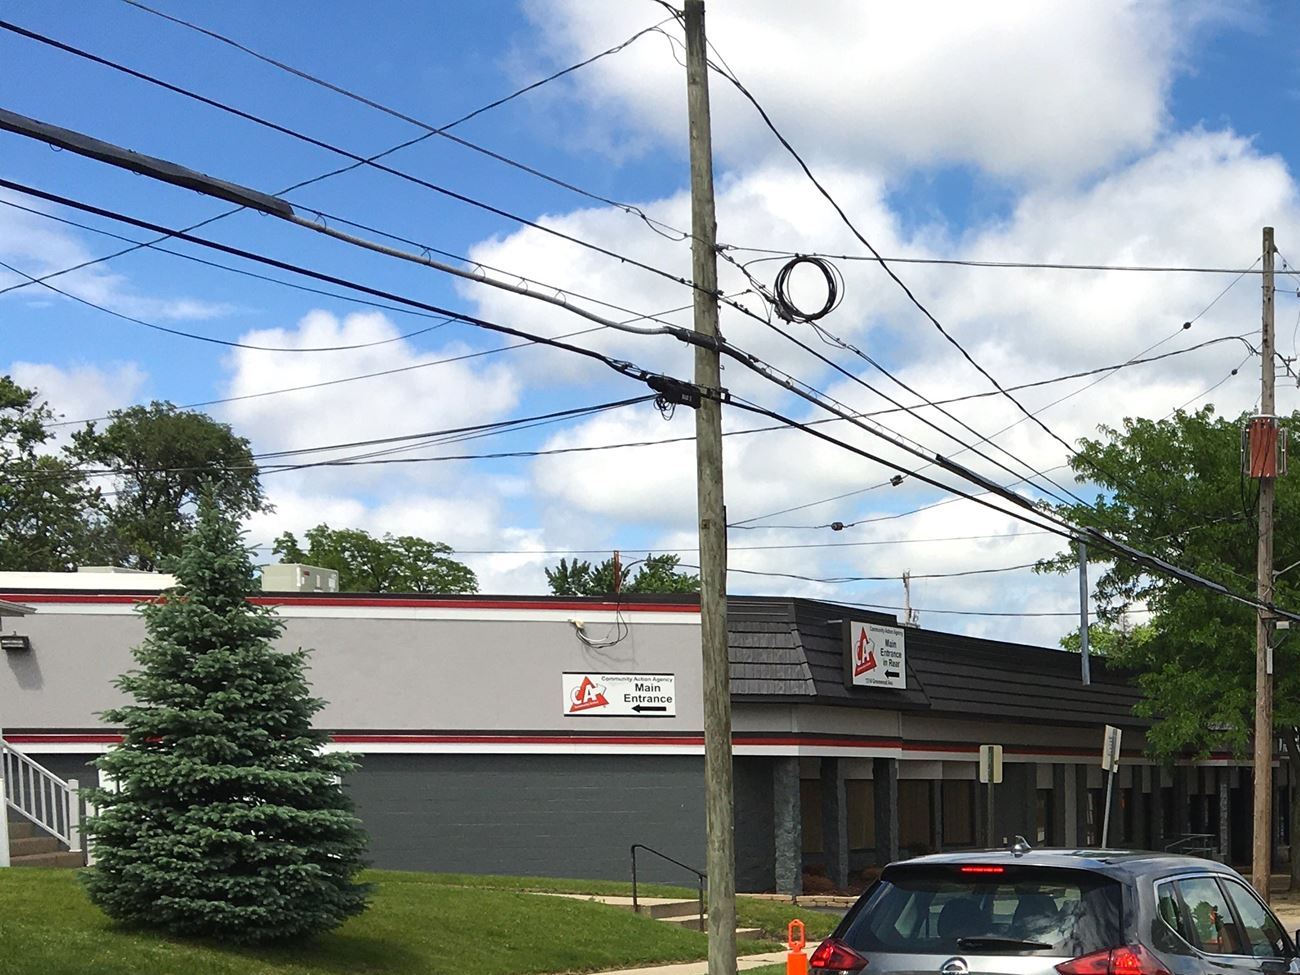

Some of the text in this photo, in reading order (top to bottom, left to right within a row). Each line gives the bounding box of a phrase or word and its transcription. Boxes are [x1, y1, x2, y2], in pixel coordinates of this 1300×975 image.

[885, 639, 897, 648] Main
[880, 647, 902, 659] Entrance
[889, 659, 900, 668] Rear
[635, 683, 661, 692] Main
[624, 694, 673, 703] Entrance
